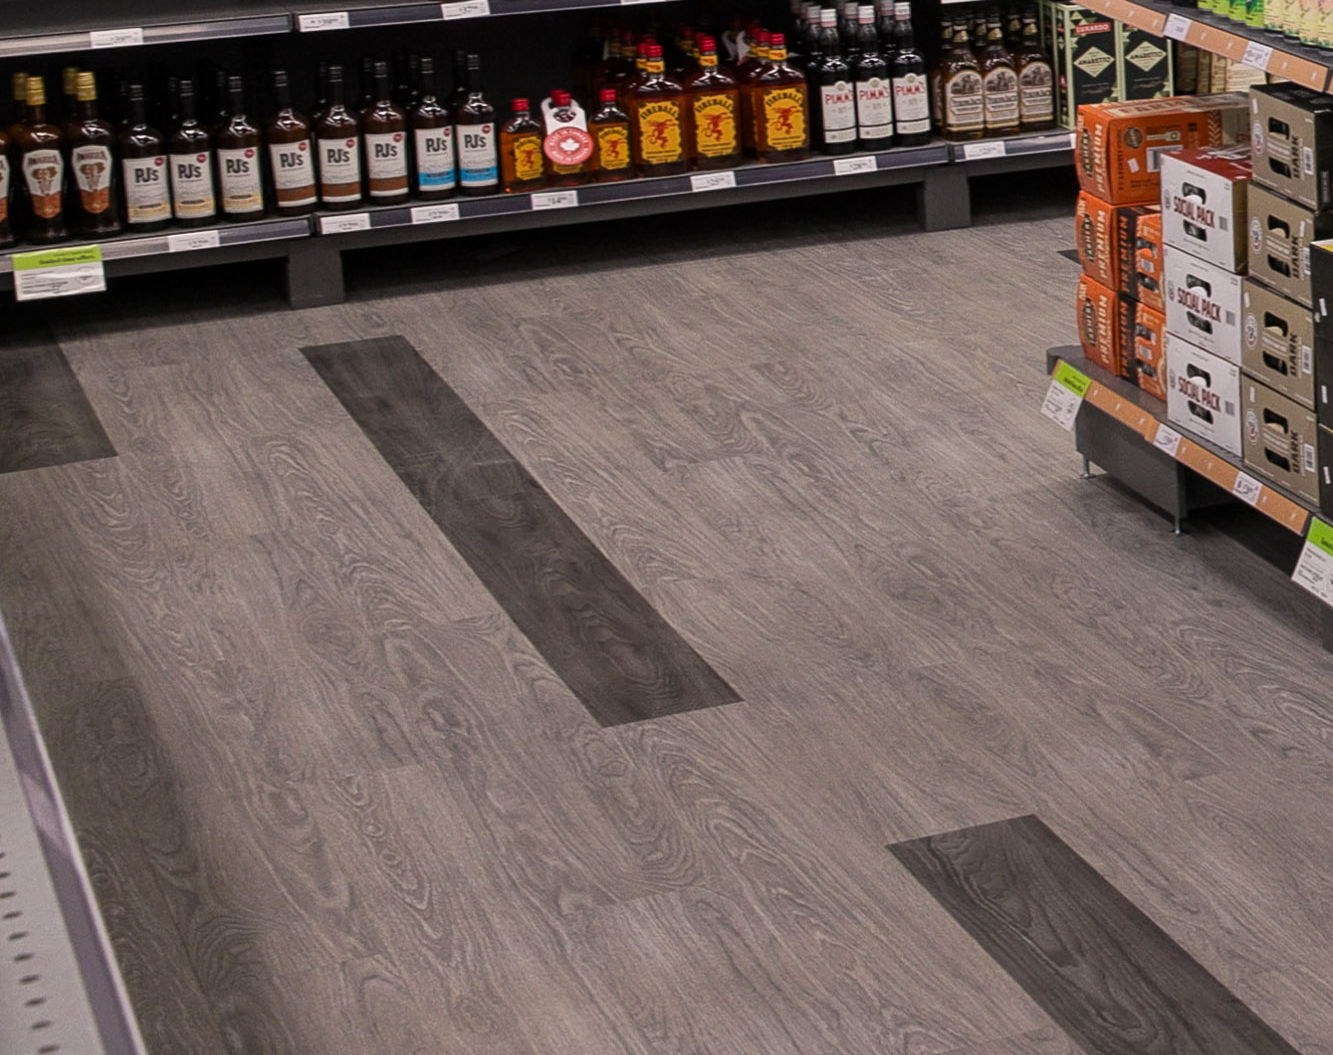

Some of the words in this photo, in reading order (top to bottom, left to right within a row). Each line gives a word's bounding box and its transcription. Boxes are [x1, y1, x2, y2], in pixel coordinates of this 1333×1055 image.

[1174, 195, 1194, 222] SOCIAL
[1196, 204, 1216, 229] PACK
[1177, 287, 1199, 313] SOCIAL
[1200, 297, 1222, 322] PACK
[1178, 376, 1199, 402] SOCIAL
[1200, 387, 1221, 413] PACK
